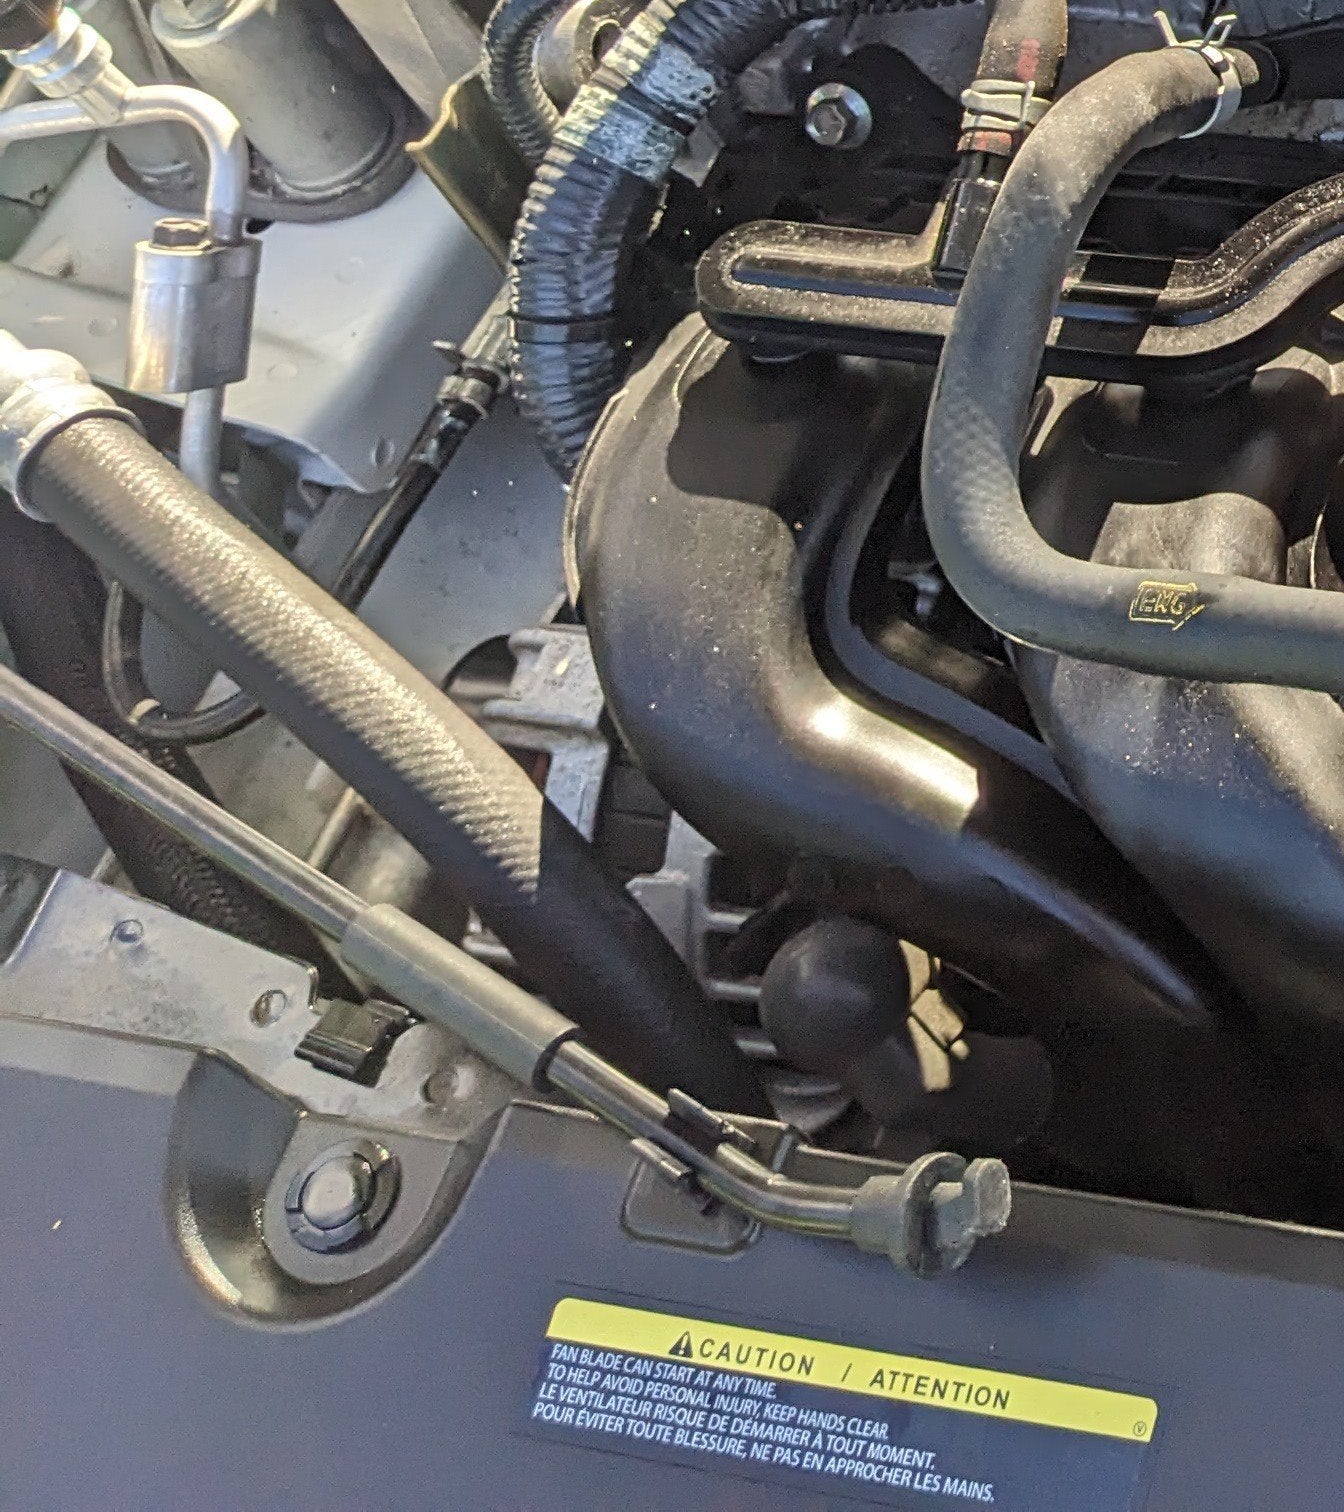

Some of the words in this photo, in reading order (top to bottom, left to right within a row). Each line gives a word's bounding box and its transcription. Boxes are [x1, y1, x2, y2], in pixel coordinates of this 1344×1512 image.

[547, 1361, 566, 1381] TO
[567, 1366, 600, 1387] HELP
[601, 1373, 643, 1395] AVOID
[643, 1380, 712, 1409] PERSONAL
[713, 1393, 762, 1420] INJURY,
[763, 1402, 797, 1422] KEEP
[797, 1407, 847, 1434] HANDS
[847, 1417, 889, 1440] CLEAR.
[550, 1343, 577, 1363] FAN
[580, 1348, 622, 1371] BLADE
[624, 1356, 651, 1375] CAN
[652, 1361, 696, 1383] START
[697, 1369, 713, 1386] AT
[713, 1372, 745, 1392] ANY
[744, 1377, 777, 1400] TIME.
[700, 1338, 815, 1376] CAUTION
[840, 1362, 854, 1383] /
[869, 1368, 1010, 1411] ATTENTION
[533, 1401, 576, 1425] POUR
[575, 1407, 625, 1433] ÉVITER
[625, 1418, 674, 1443] TOUTE
[674, 1428, 749, 1460] BLESSURE,
[750, 1442, 771, 1462] NE
[773, 1446, 801, 1468] PAS
[801, 1451, 824, 1472] EN
[824, 1455, 912, 1488] APPROCHER
[912, 1470, 942, 1494] LES
[941, 1476, 996, 1505] MAINS.
[539, 1381, 558, 1400] LE
[559, 1385, 652, 1419] VENTILATEUR
[652, 1405, 706, 1430] RISQUE
[707, 1413, 728, 1433] DE
[729, 1416, 810, 1449] DÉMARRER
[810, 1429, 823, 1450] À
[826, 1433, 865, 1457] TOUT
[865, 1441, 937, 1472] MOMENT.
